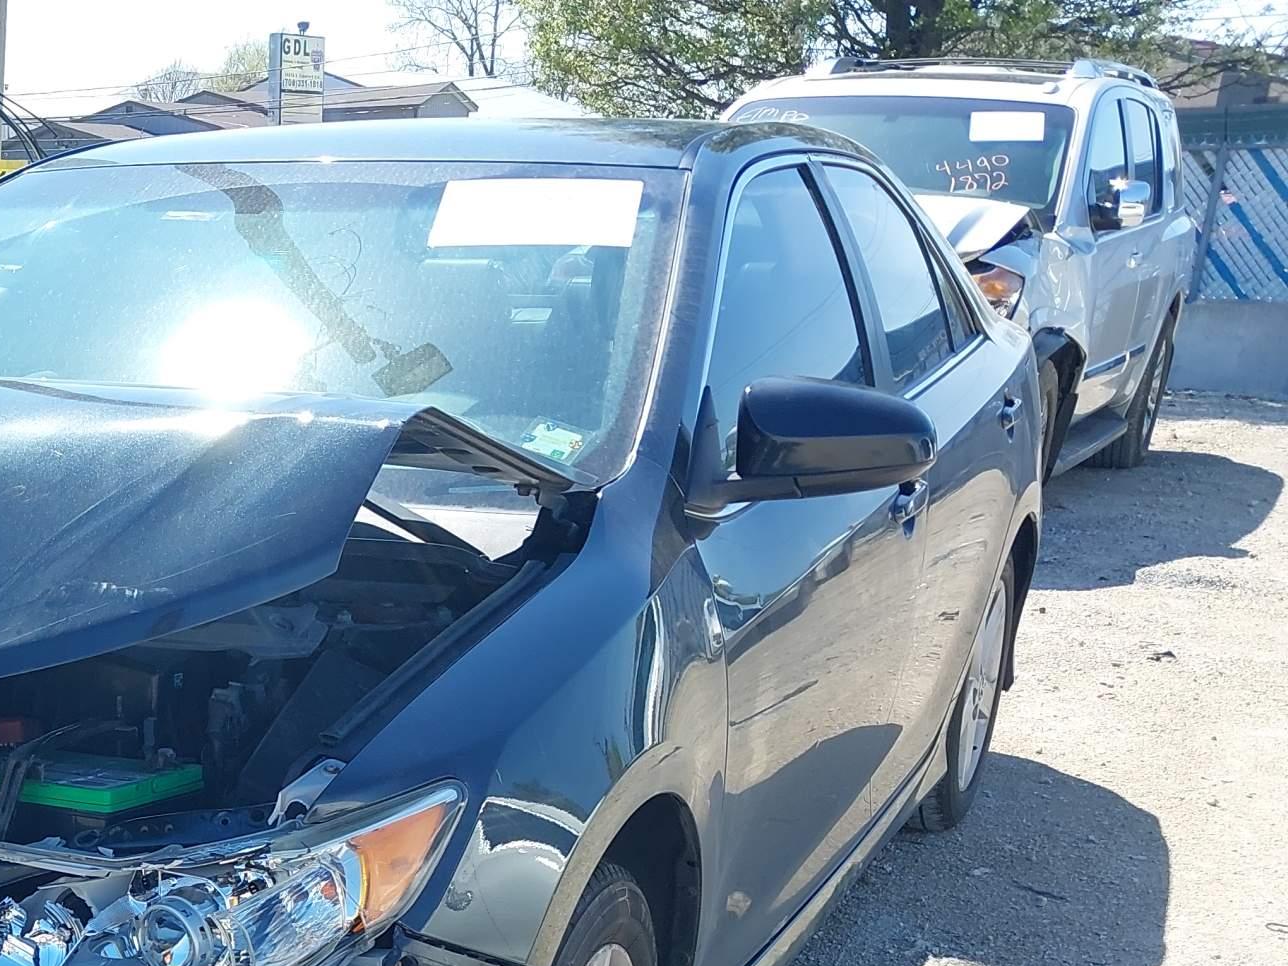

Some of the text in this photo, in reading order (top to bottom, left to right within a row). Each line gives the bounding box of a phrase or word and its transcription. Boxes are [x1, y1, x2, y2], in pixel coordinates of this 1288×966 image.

[283, 38, 310, 56] GDL
[935, 154, 1010, 176] 4490
[949, 171, 1009, 193] 1872
